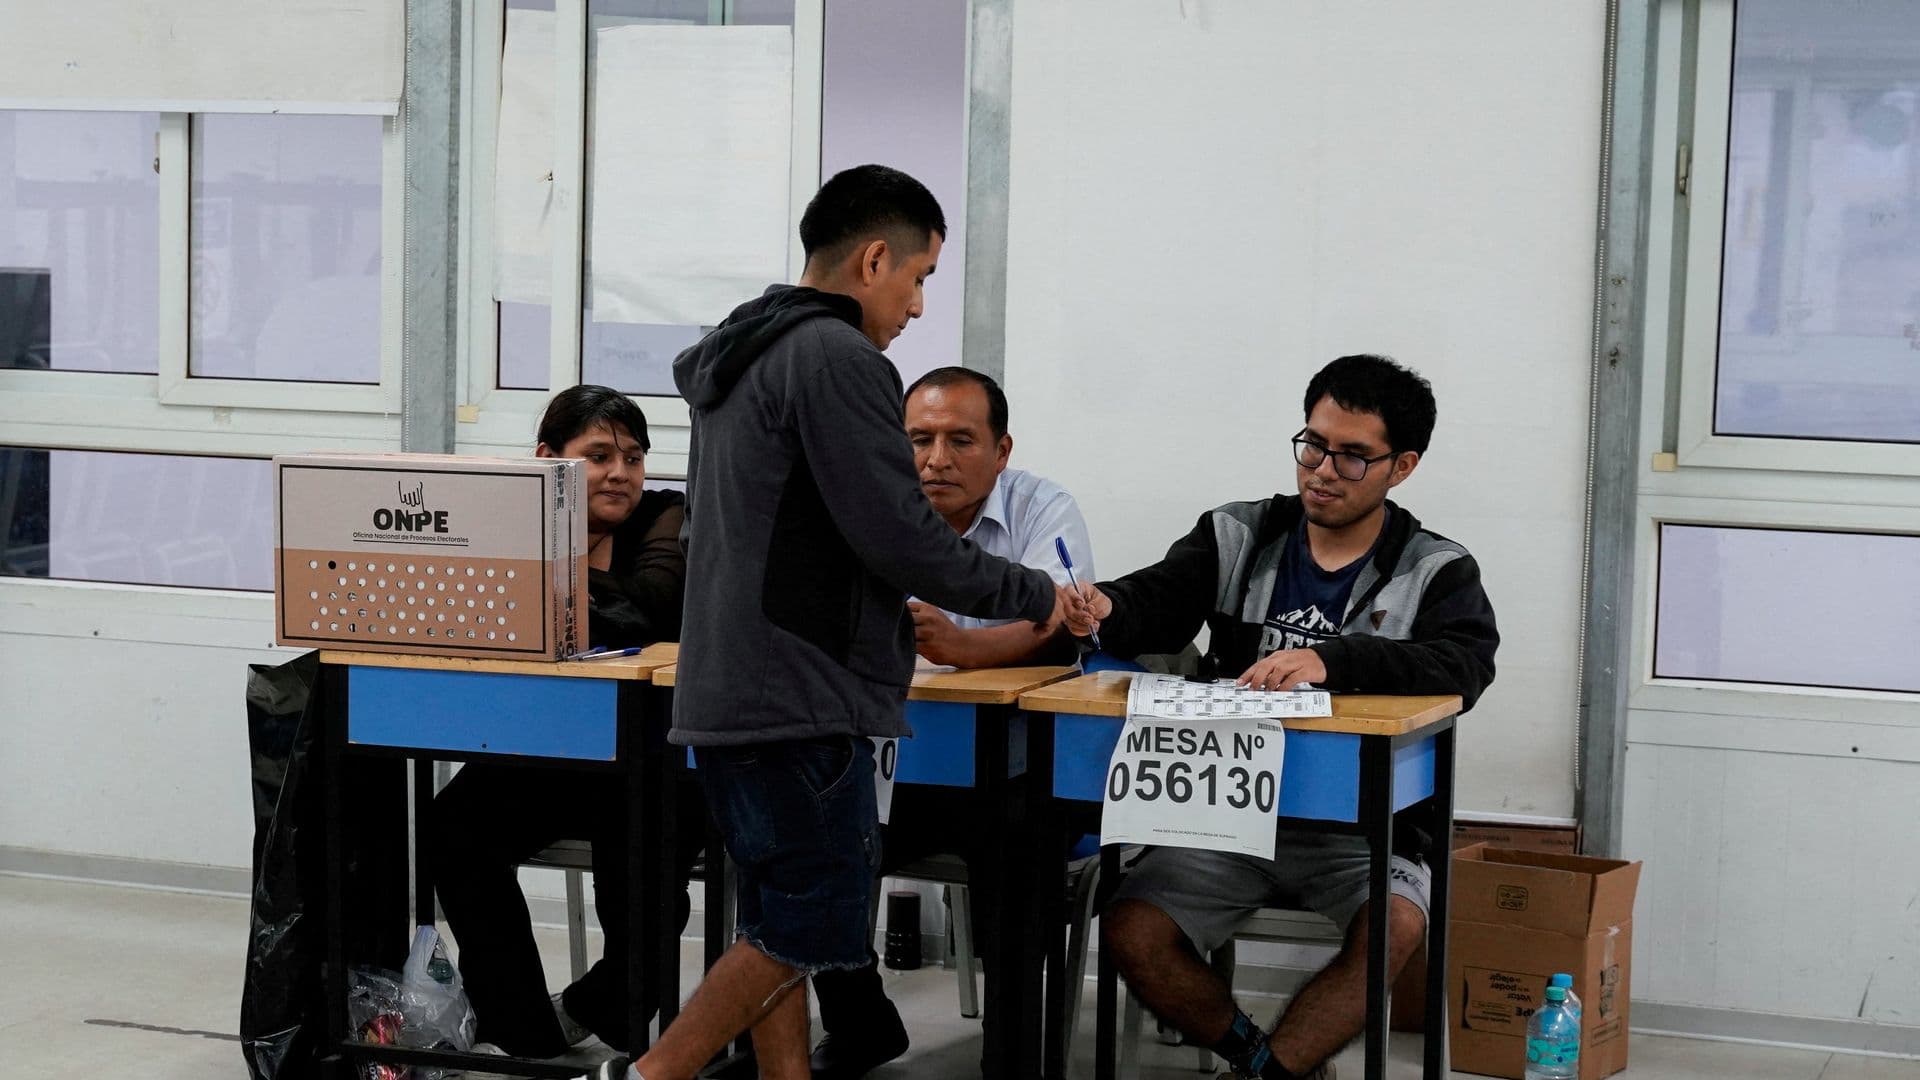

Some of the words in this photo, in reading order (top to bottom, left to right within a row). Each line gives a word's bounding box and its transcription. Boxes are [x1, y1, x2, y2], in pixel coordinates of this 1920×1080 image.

[373, 508, 449, 533] ONPE
[1126, 726, 1223, 757] MESA
[1108, 759, 1276, 813] 056130
